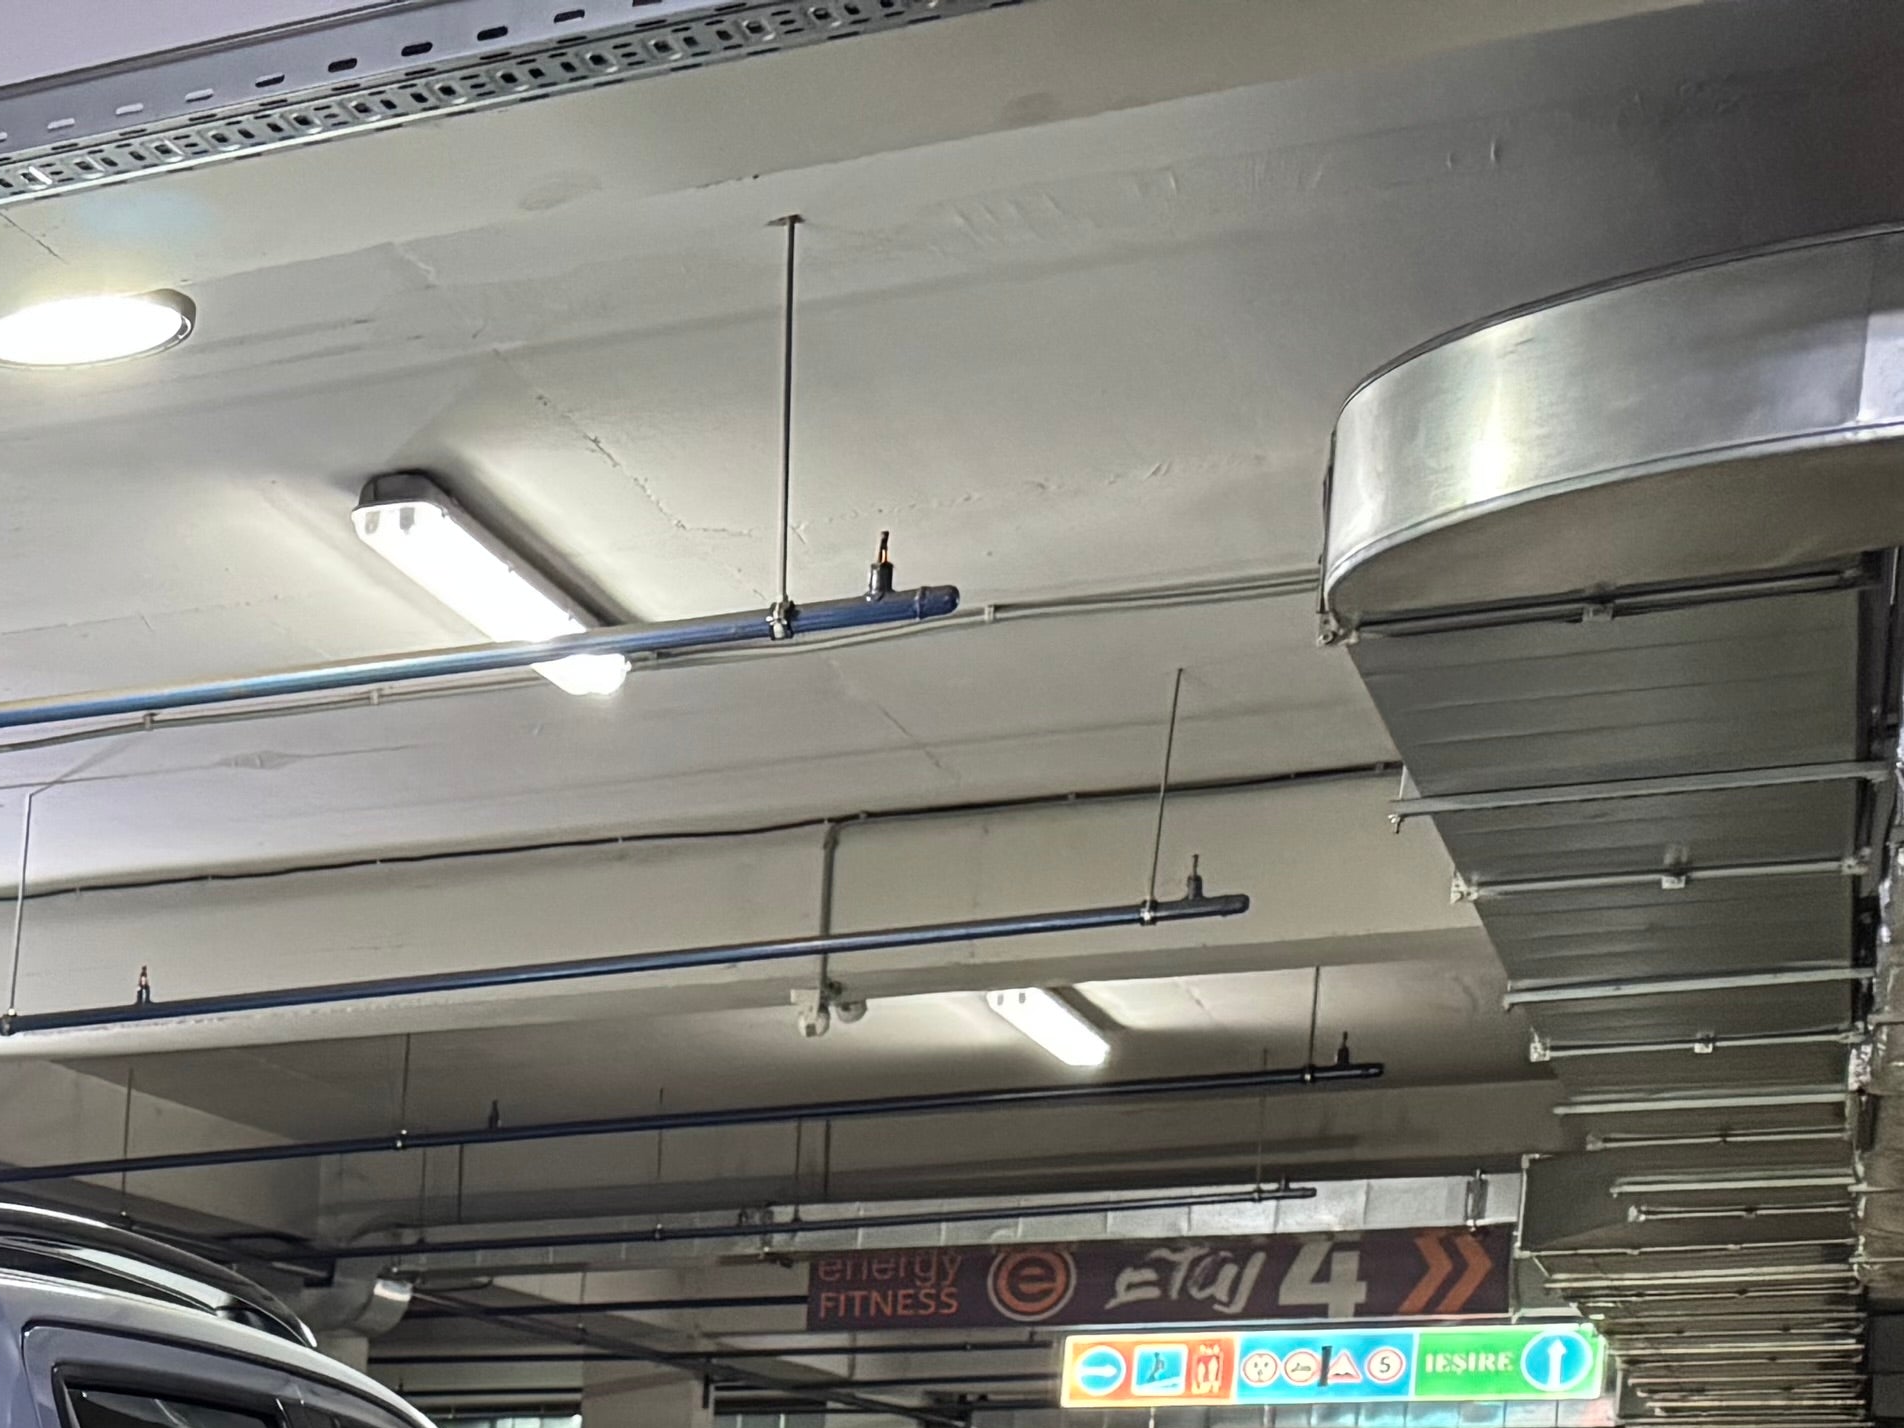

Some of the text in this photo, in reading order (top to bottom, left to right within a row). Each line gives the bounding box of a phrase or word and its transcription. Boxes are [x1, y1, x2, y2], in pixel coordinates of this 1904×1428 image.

[818, 1248, 962, 1287] energy
[1278, 1233, 1368, 1318] 4
[819, 1288, 960, 1319] FITNESS
[1378, 1356, 1392, 1373] 5
